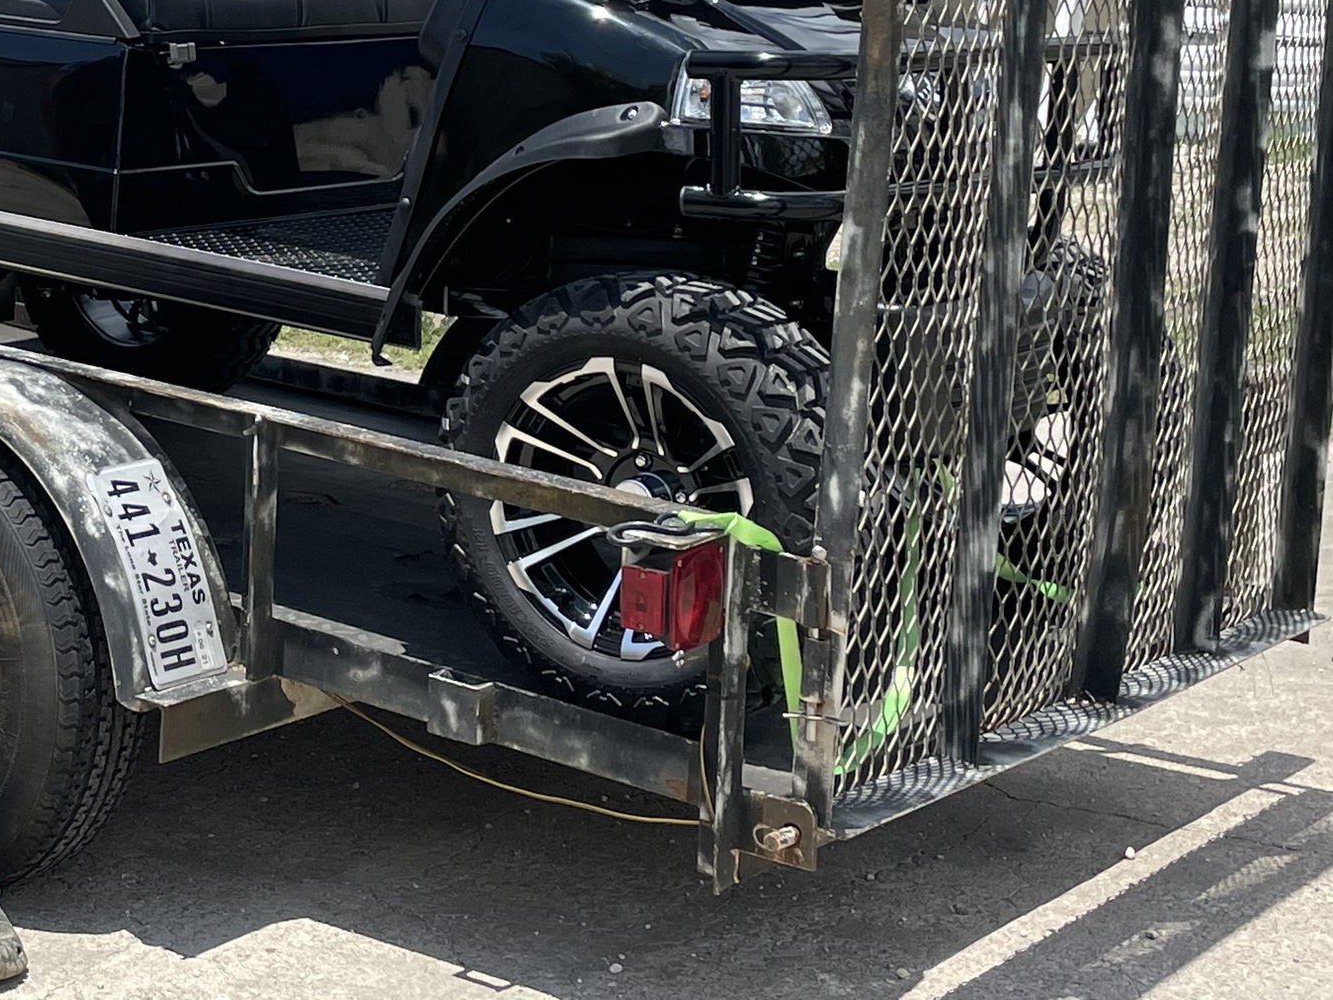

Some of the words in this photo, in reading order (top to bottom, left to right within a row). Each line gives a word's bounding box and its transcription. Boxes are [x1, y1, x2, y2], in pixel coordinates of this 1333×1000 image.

[115, 523, 126, 545] The
[124, 545, 137, 571] Lone
[134, 573, 145, 595] Star
[141, 598, 152, 627] State
[168, 538, 190, 592] TRAILER
[170, 519, 206, 605] TEXAS
